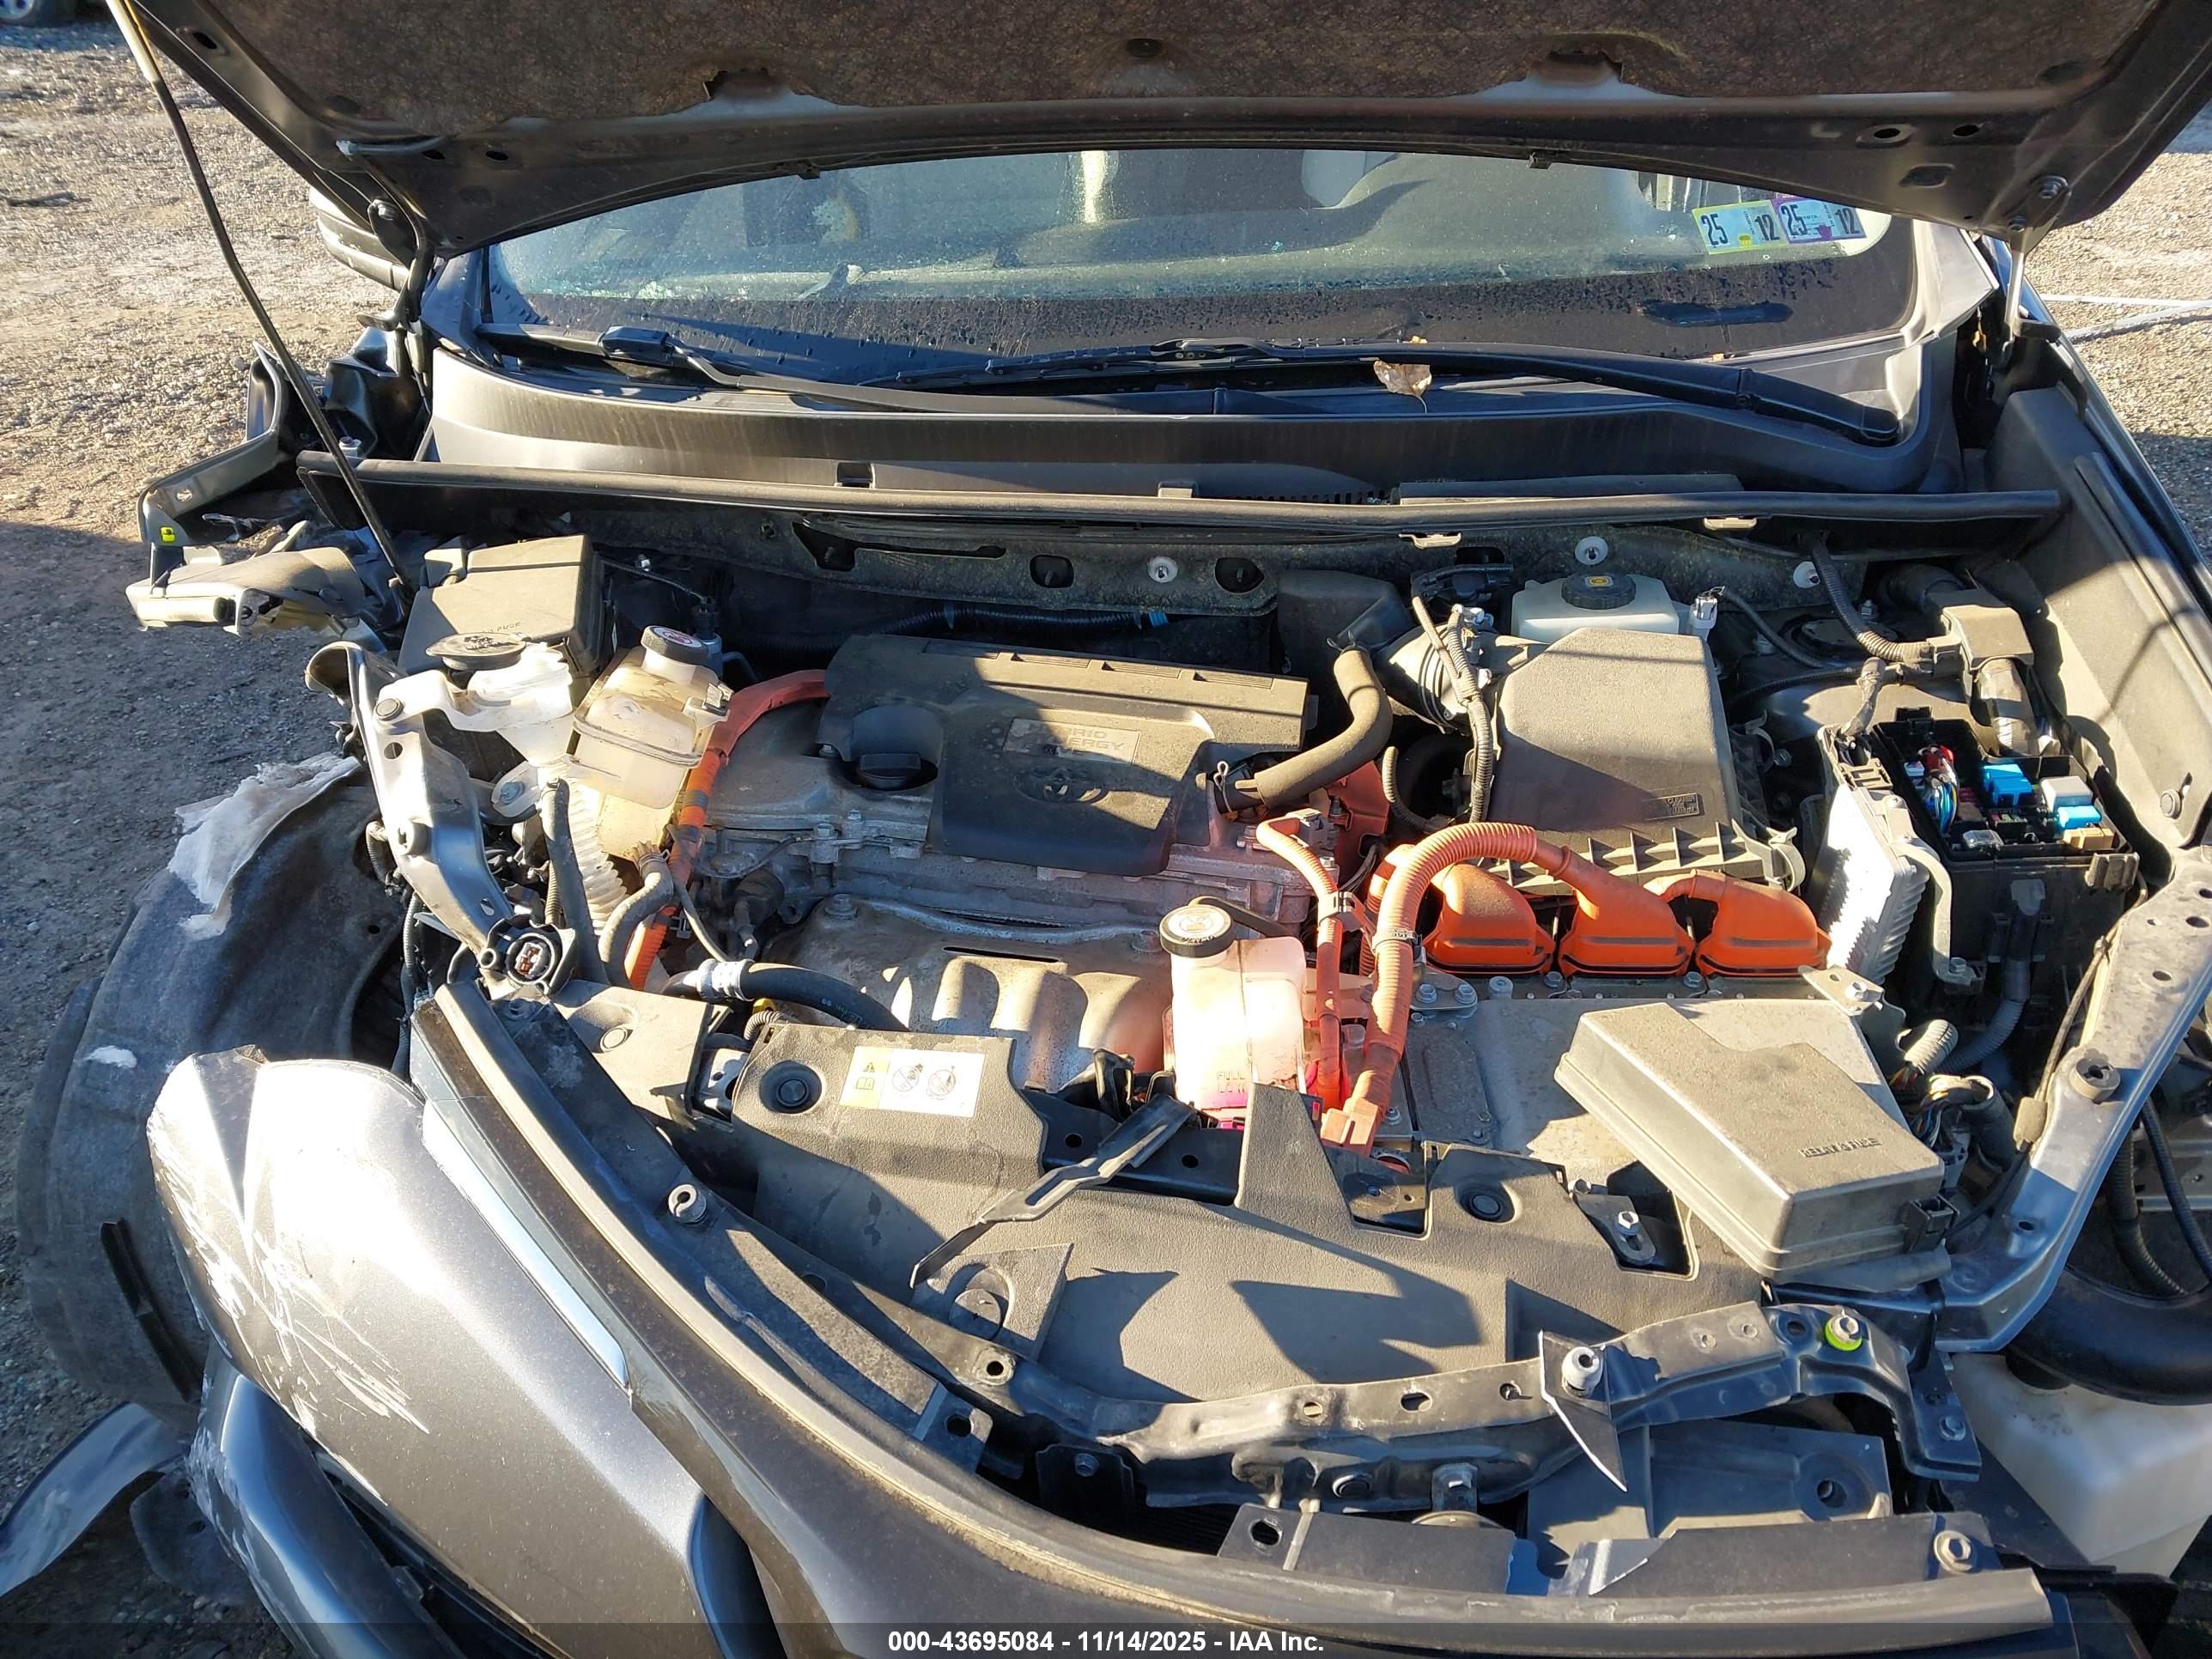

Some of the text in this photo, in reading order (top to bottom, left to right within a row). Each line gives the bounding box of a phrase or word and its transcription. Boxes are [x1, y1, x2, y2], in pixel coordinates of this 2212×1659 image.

[1701, 213, 1729, 246] 25
[1754, 214, 1780, 241] 12
[1780, 204, 1808, 236] 25
[1835, 207, 1860, 234] 12
[1216, 1071, 1246, 1080] FULL
[1218, 1082, 1245, 1093] LOW
